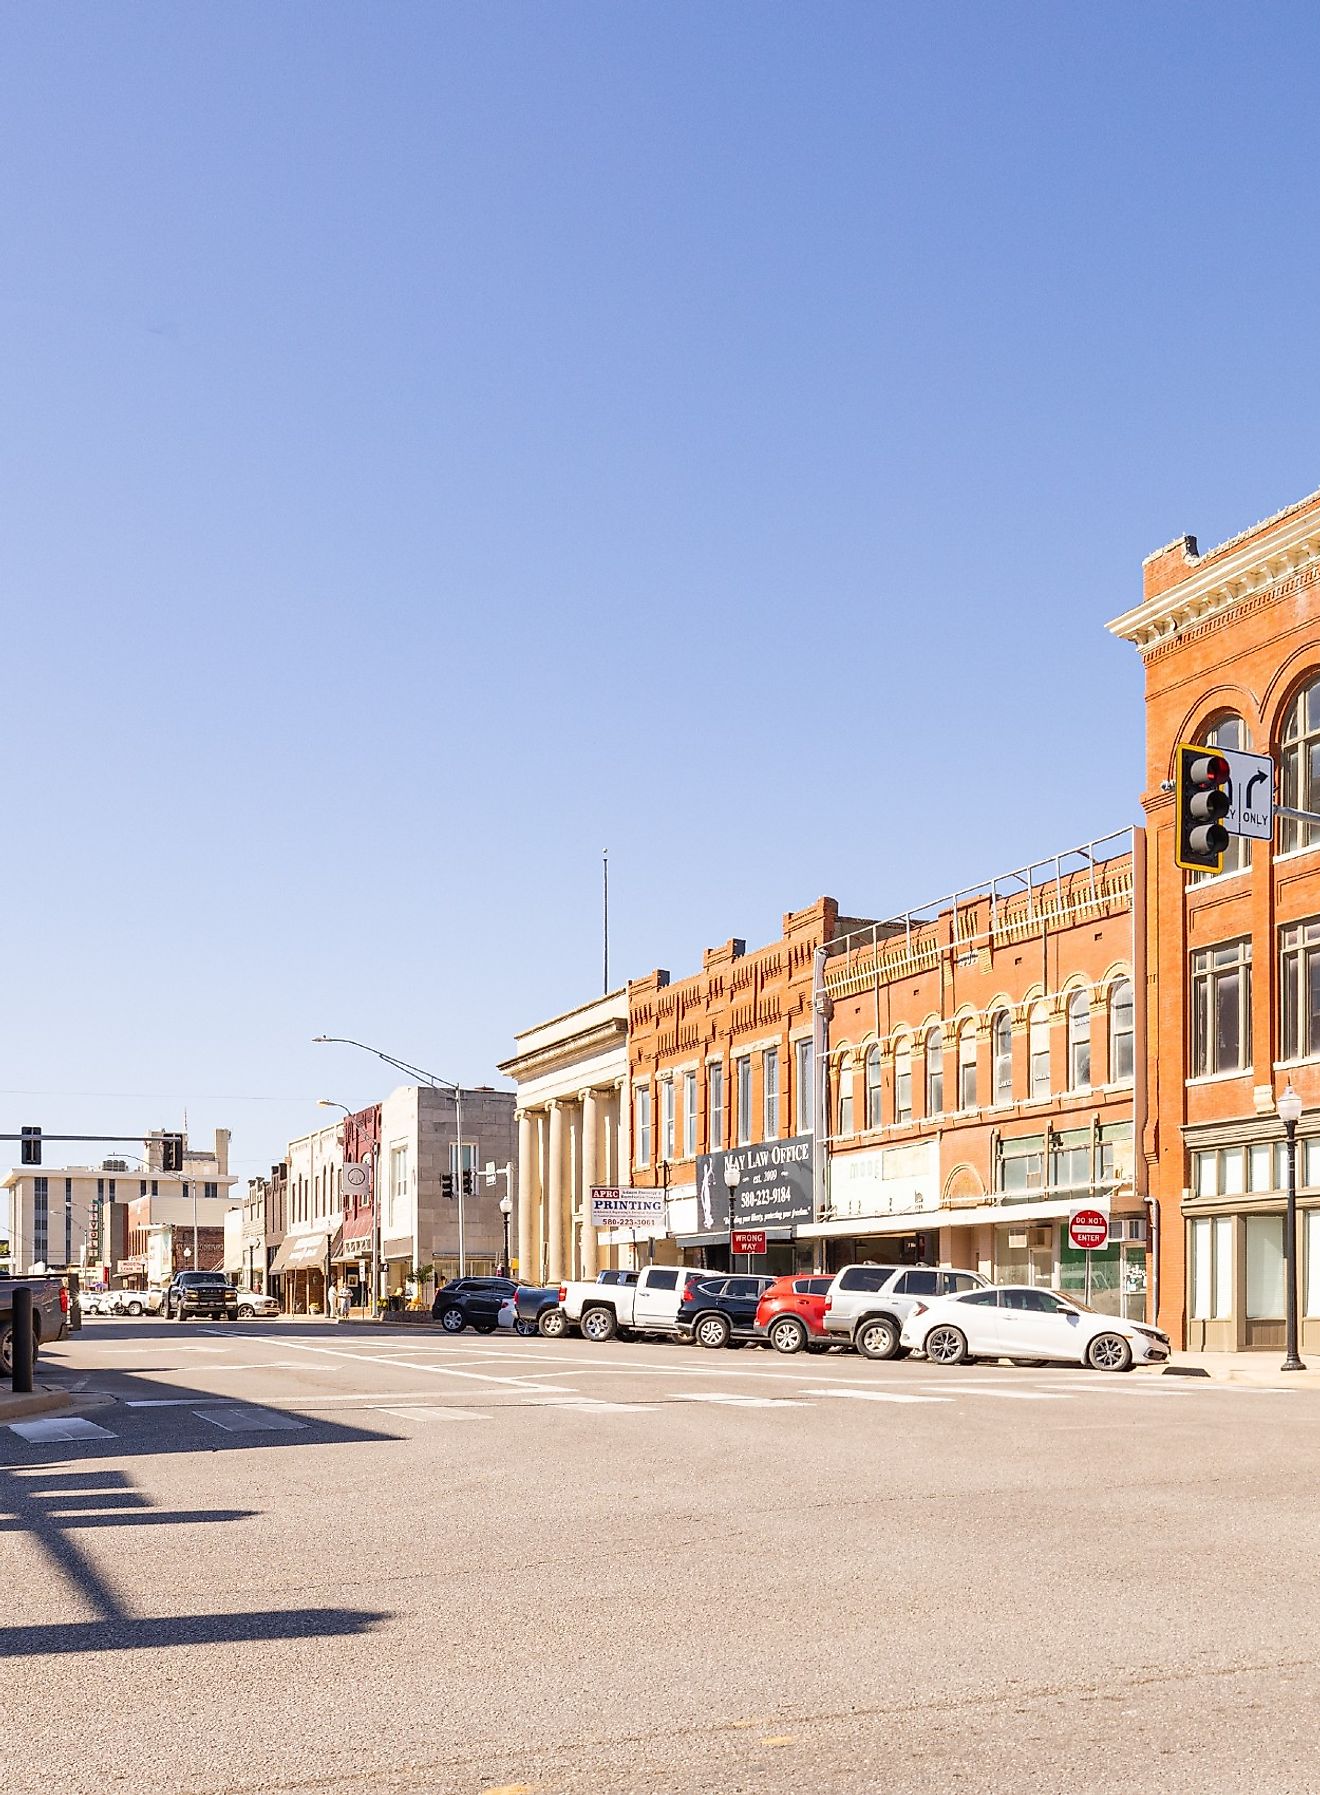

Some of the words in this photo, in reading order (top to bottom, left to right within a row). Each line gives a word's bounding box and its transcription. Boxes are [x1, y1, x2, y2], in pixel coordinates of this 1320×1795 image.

[1243, 811, 1268, 825] ONLY
[747, 1150, 770, 1169] LAW
[771, 1143, 809, 1165] OFFICE
[593, 1190, 619, 1198] APRC
[740, 1186, 791, 1208] 580-223-9184
[594, 1200, 661, 1210] PRINTING
[735, 1234, 763, 1242] WRONG
[1078, 1234, 1100, 1242] ENTER
